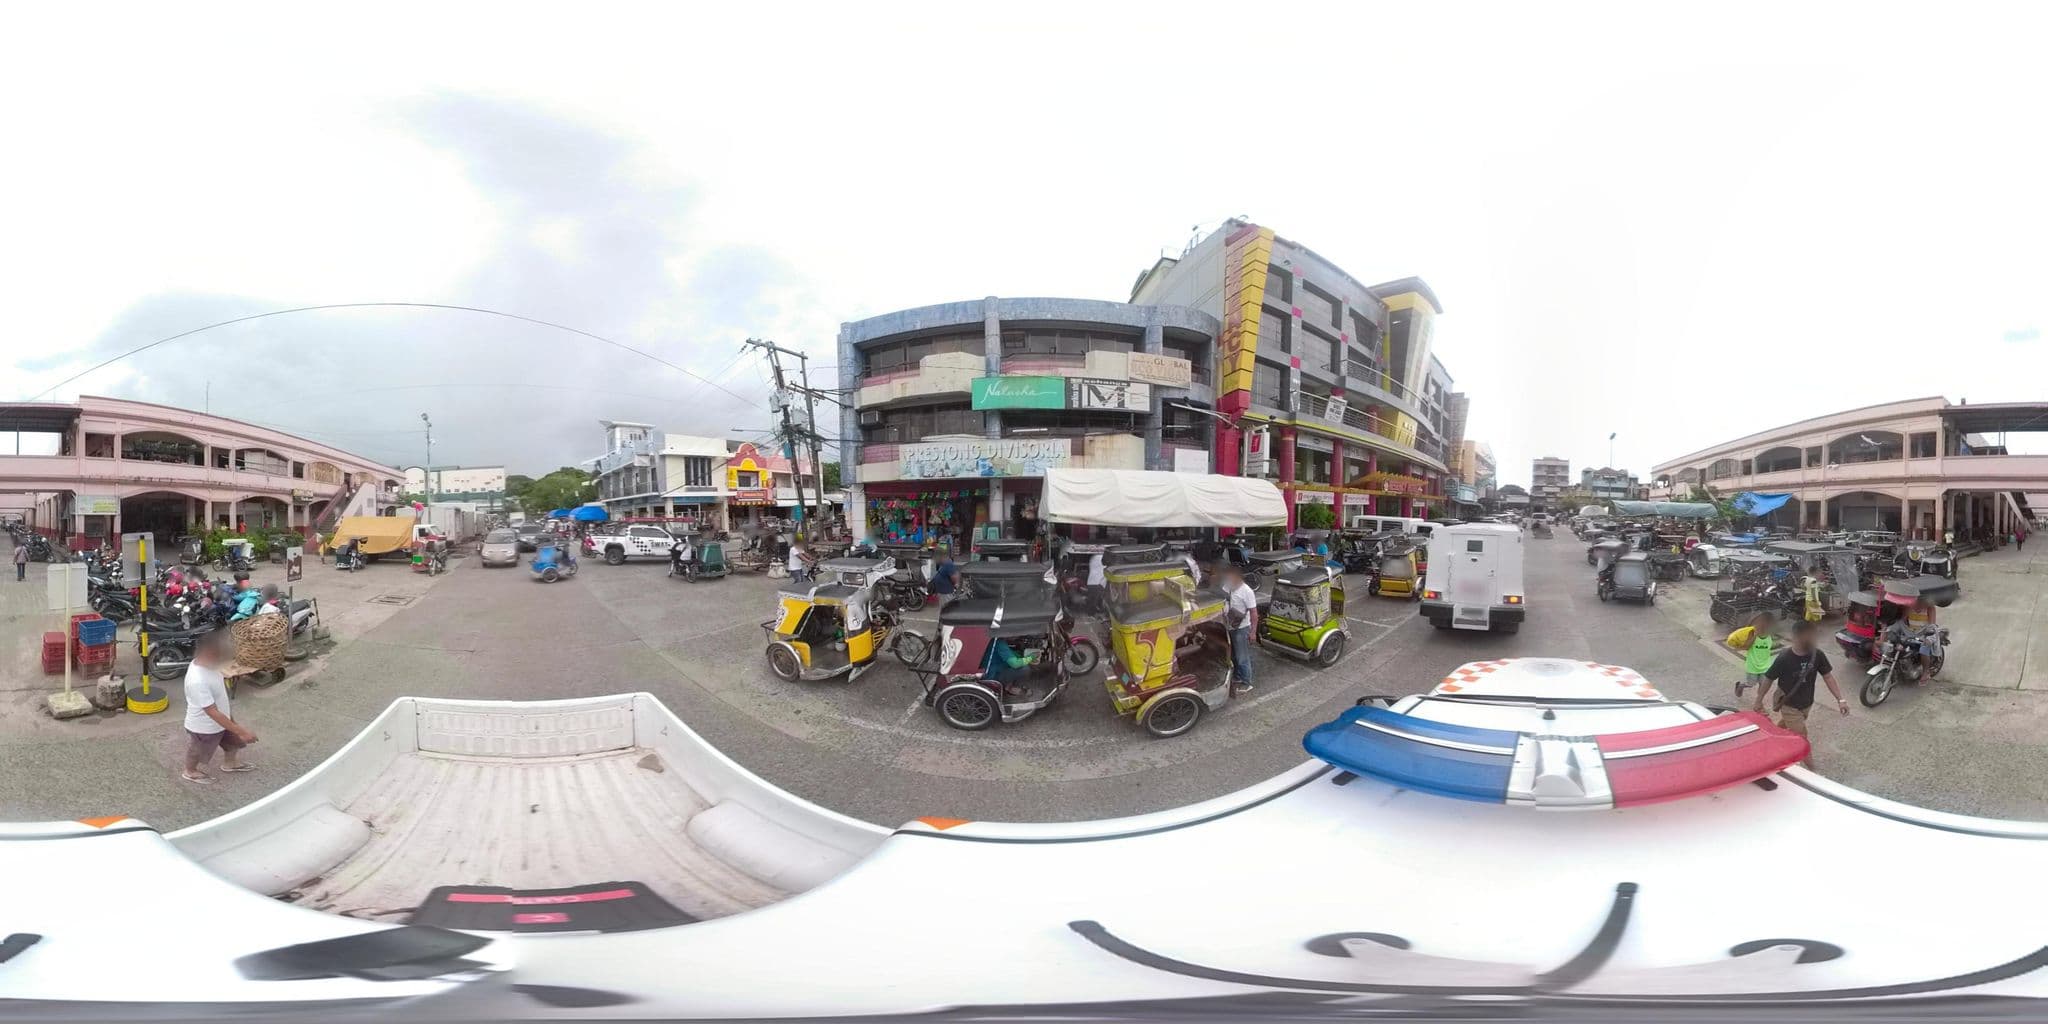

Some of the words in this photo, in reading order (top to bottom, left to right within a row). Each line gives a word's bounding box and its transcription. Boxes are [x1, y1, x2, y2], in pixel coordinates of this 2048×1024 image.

[980, 379, 1057, 404] Natasha
[905, 442, 981, 463] PRESYONG
[988, 438, 1067, 461] DIVISORIA
